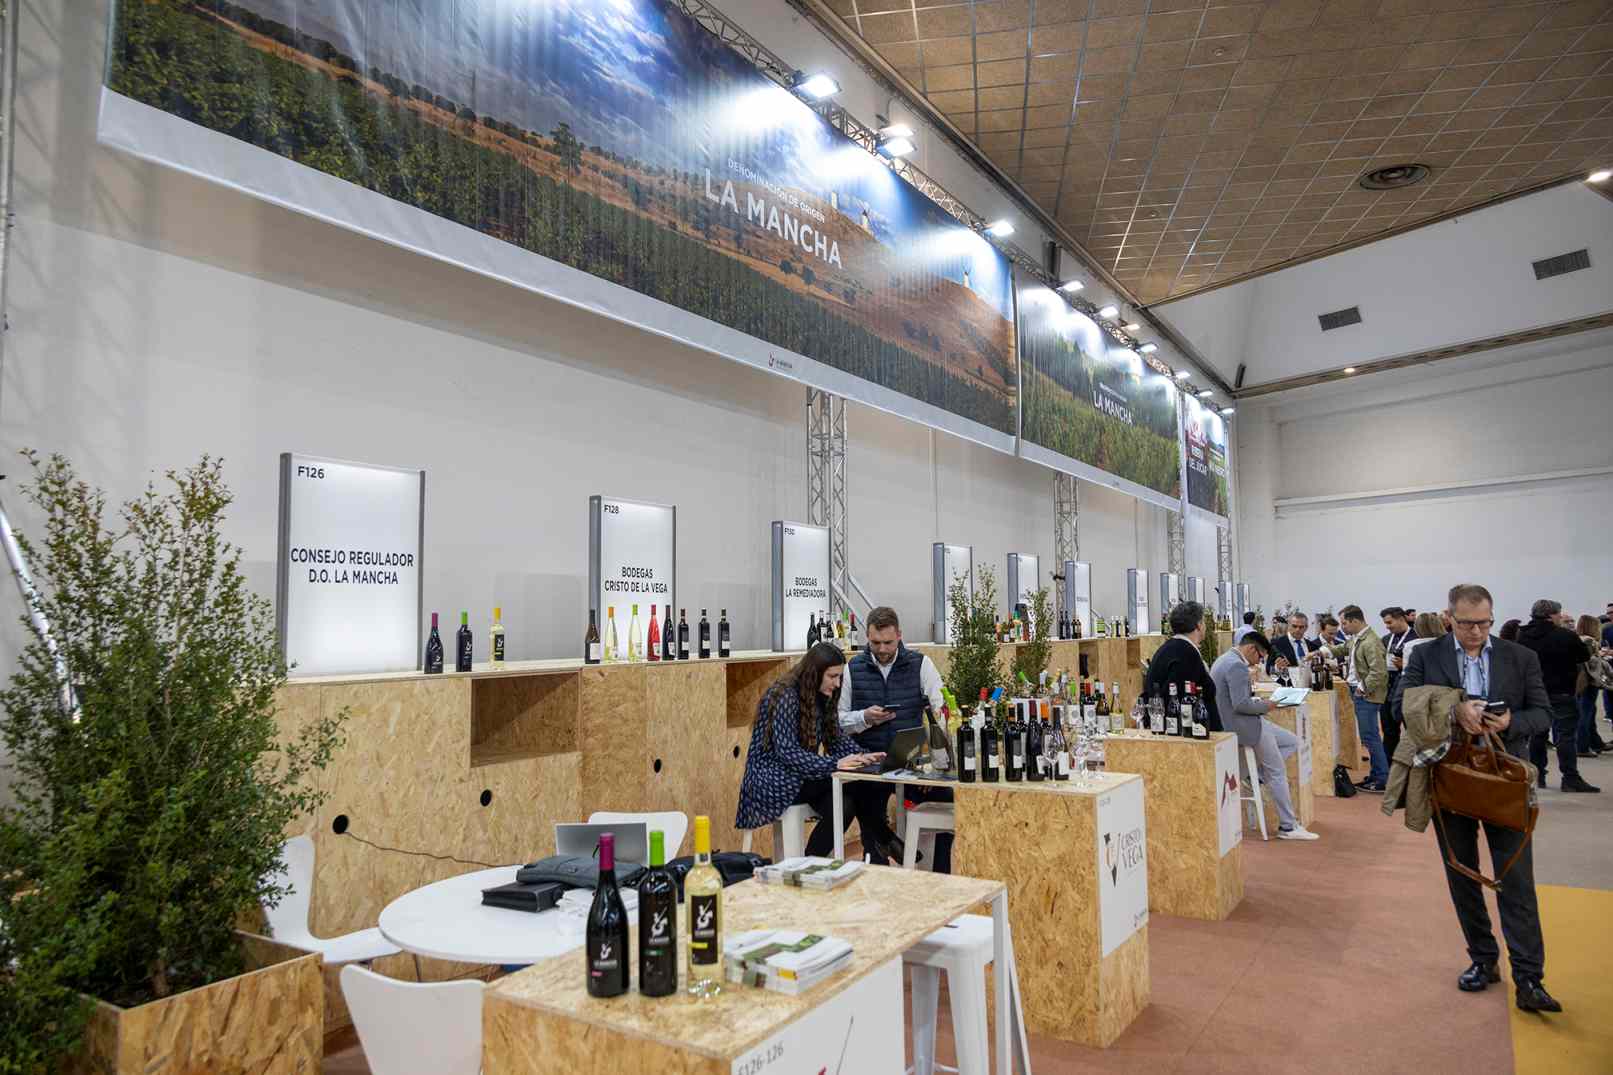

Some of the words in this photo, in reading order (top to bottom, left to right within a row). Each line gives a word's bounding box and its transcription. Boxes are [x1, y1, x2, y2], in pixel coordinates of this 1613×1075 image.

[705, 168, 739, 214] LA
[747, 191, 842, 270] MANCHA
[1093, 390, 1104, 411] LA
[1104, 396, 1133, 426] MANCHA
[297, 466, 325, 480] F126
[604, 504, 620, 514] F128
[290, 548, 346, 565] CONSEJO
[349, 550, 414, 567] REGULADOR
[308, 569, 332, 584] D.O.
[334, 569, 349, 584] LA
[352, 570, 399, 585] MANCHA
[621, 566, 653, 579] BODEGAS
[604, 580, 629, 592] CRISTO
[630, 581, 640, 593] DE
[641, 582, 650, 593] LA
[651, 583, 668, 593] VEGA
[795, 576, 818, 586] BODEGAS
[785, 588, 793, 598] LA
